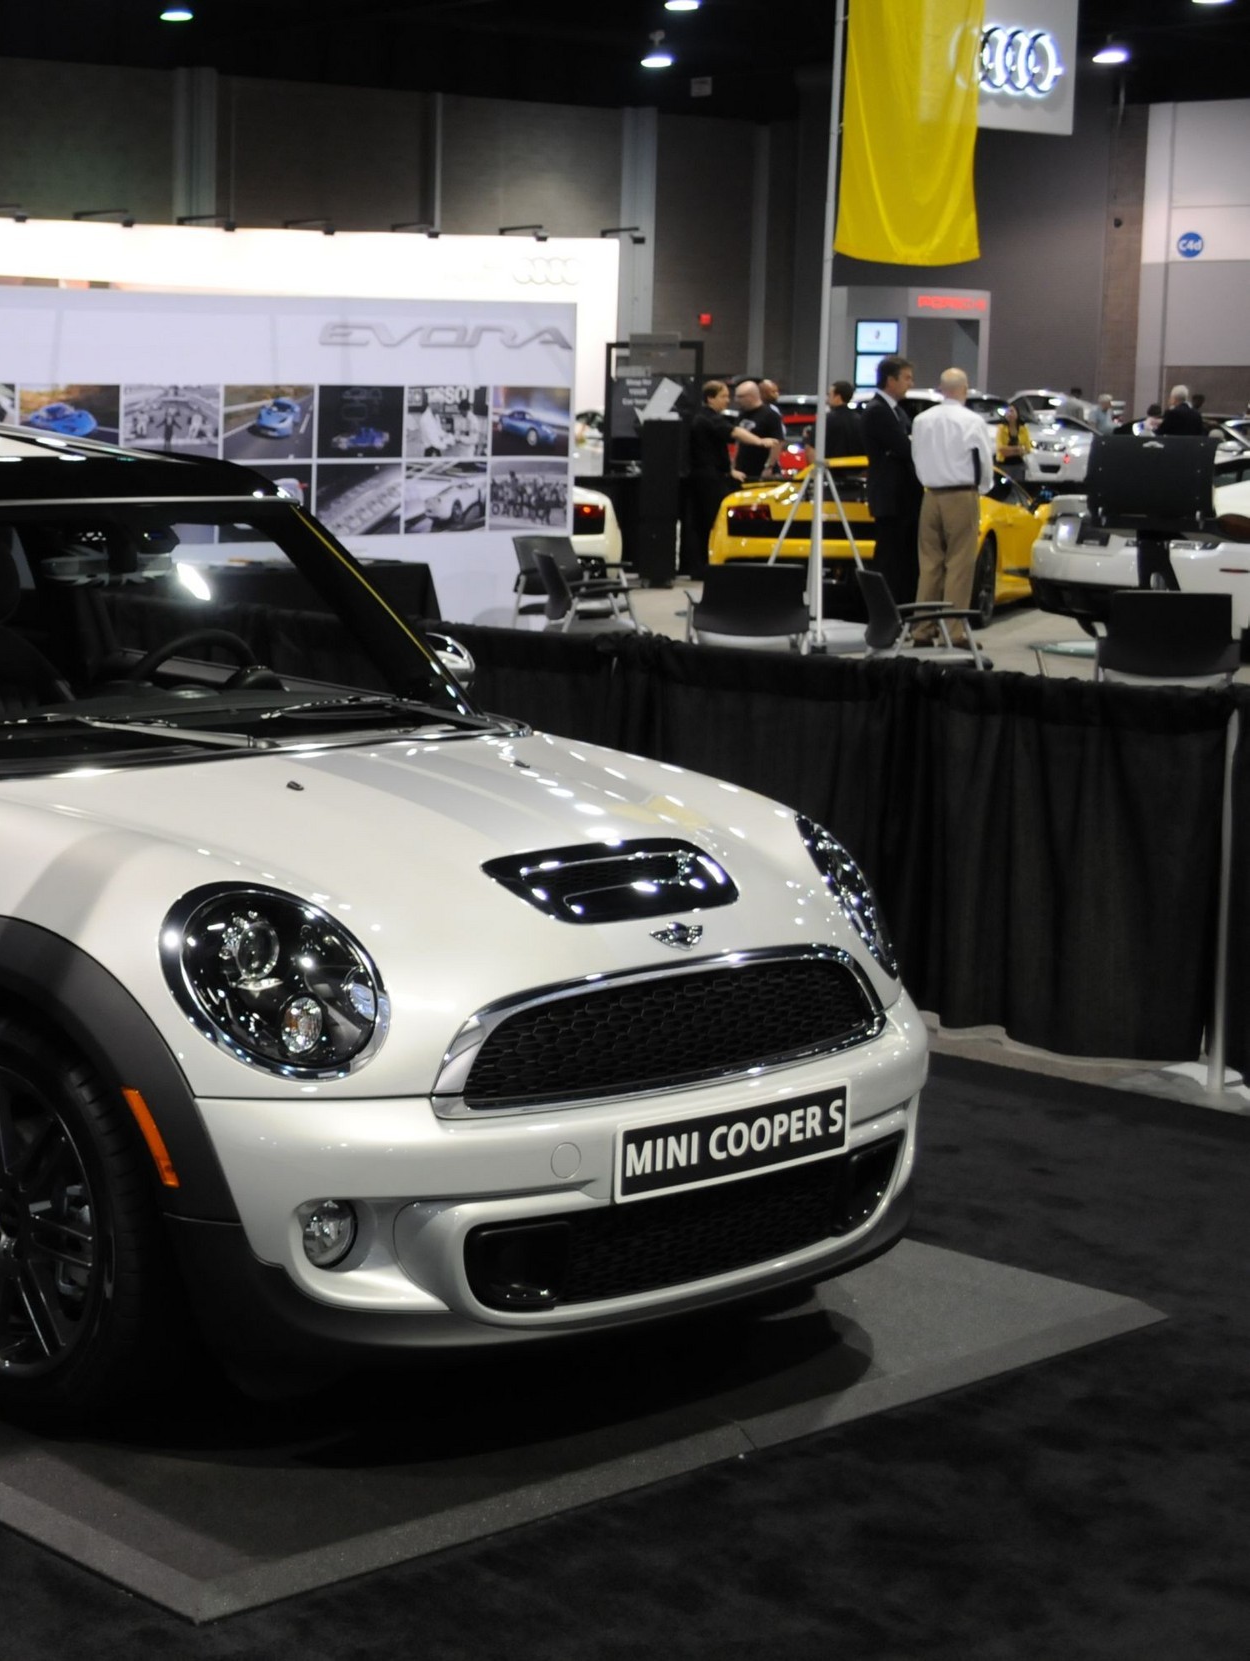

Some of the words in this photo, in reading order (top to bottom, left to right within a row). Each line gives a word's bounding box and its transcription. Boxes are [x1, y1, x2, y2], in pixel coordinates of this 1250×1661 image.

[318, 322, 573, 350] EVORA
[625, 1131, 699, 1178] MINI
[709, 1105, 823, 1160] COOPER
[829, 1099, 843, 1134] S
